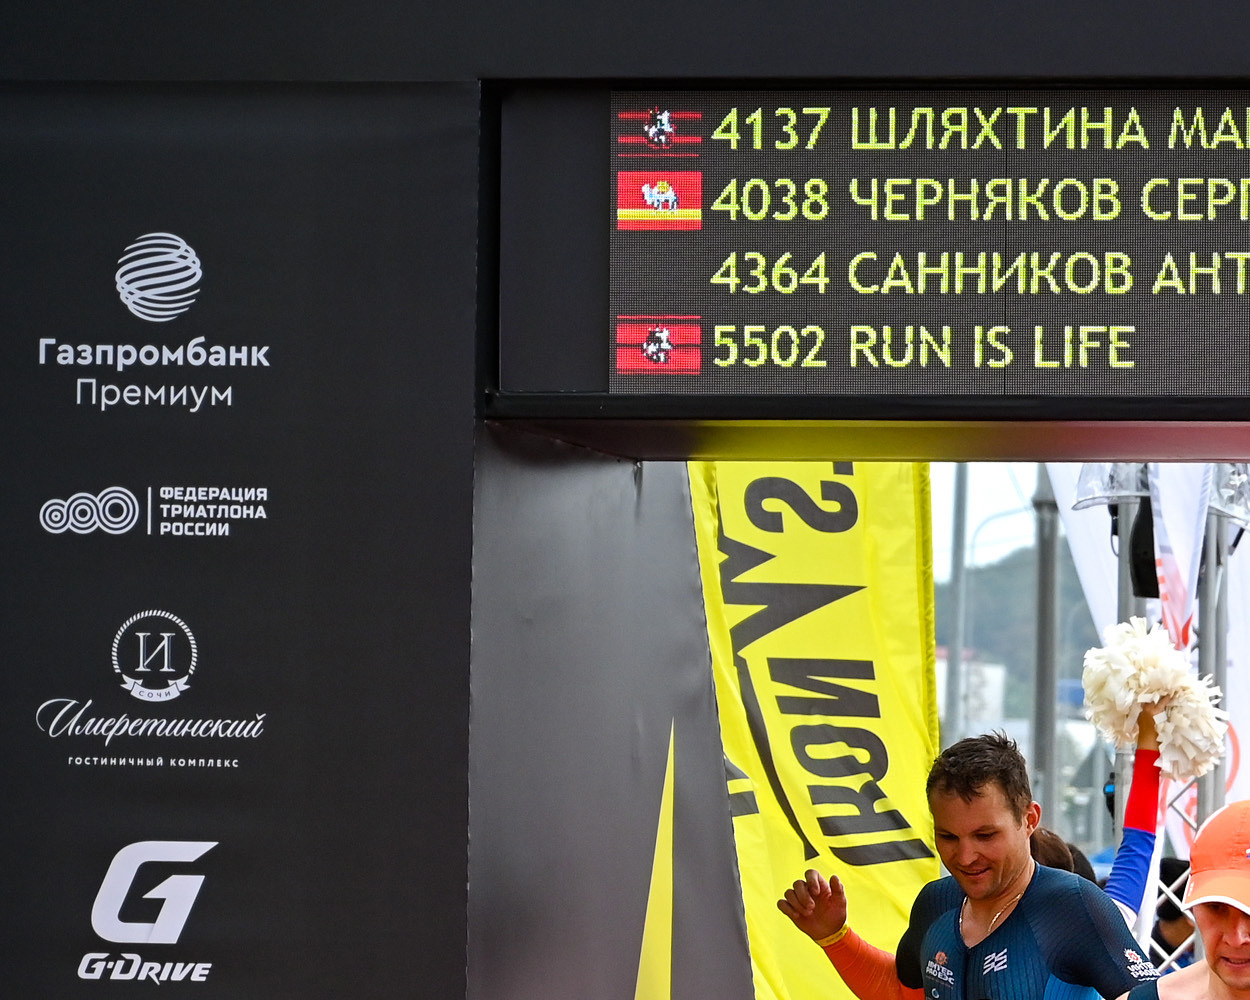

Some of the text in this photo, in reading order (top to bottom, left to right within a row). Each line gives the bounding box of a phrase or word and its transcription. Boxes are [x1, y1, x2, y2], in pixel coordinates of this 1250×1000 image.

[711, 106, 831, 150] 4137
[850, 106, 1150, 150] ШЛЯХТИНА
[711, 177, 830, 221] 4038
[850, 177, 1122, 221] ЧЕРНЯКОВ
[710, 251, 830, 294] 4364
[848, 251, 1134, 295] САННИКОВ
[38, 336, 271, 371] Газпромбанк
[713, 324, 1136, 369] 5502 RUN IS LIFE
[75, 377, 233, 413] Премиум
[159, 486, 268, 504] ФЕДЕРАЦИЯ
[159, 504, 267, 520] ТРИАТЛОНА
[160, 521, 230, 536] РОССИИ
[138, 690, 171, 699] СОЧИ
[36, 698, 266, 747] Имеретинский
[68, 756, 239, 768] ГОСТИНИЧНЫЙ КОМПЛЕКС
